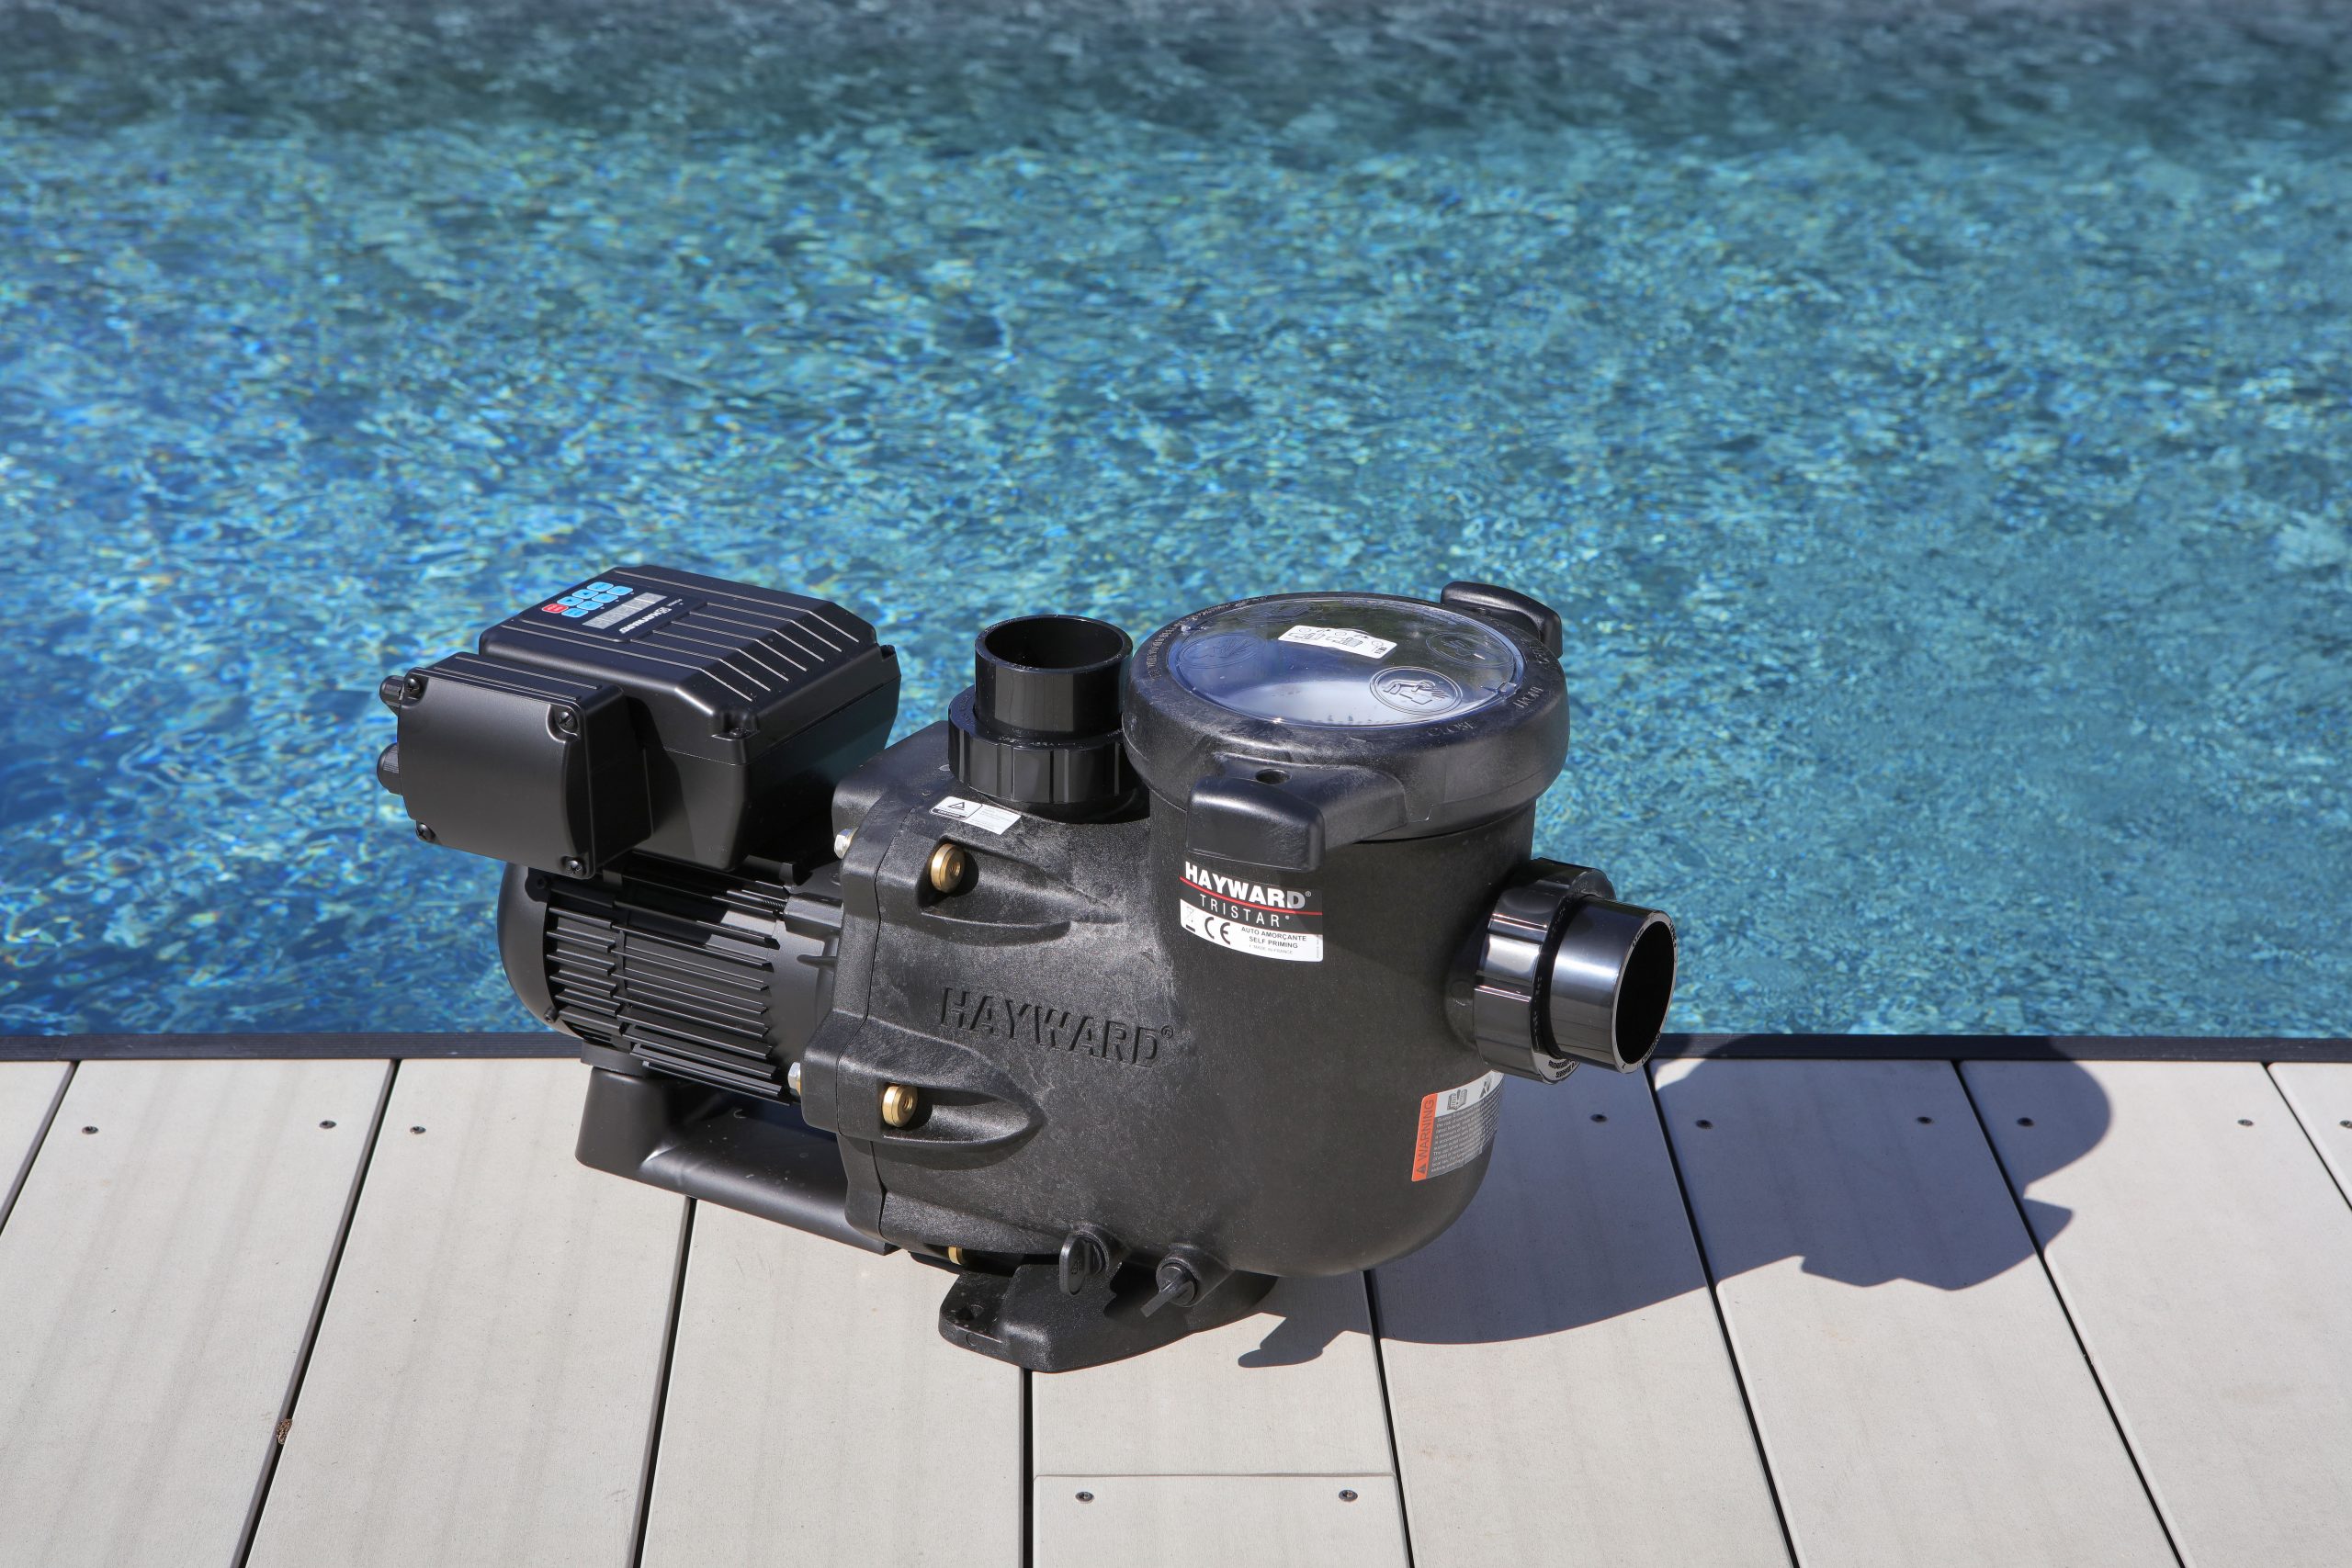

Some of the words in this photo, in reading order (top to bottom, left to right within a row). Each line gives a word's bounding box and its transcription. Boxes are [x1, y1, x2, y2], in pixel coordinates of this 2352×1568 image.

[1241, 926, 1261, 936] AUTO
[1261, 931, 1307, 942] AMORÇANTE
[1249, 935, 1267, 944] SELF
[1268, 939, 1299, 949] PRIMING
[1418, 1099, 1435, 1161] WARNING
